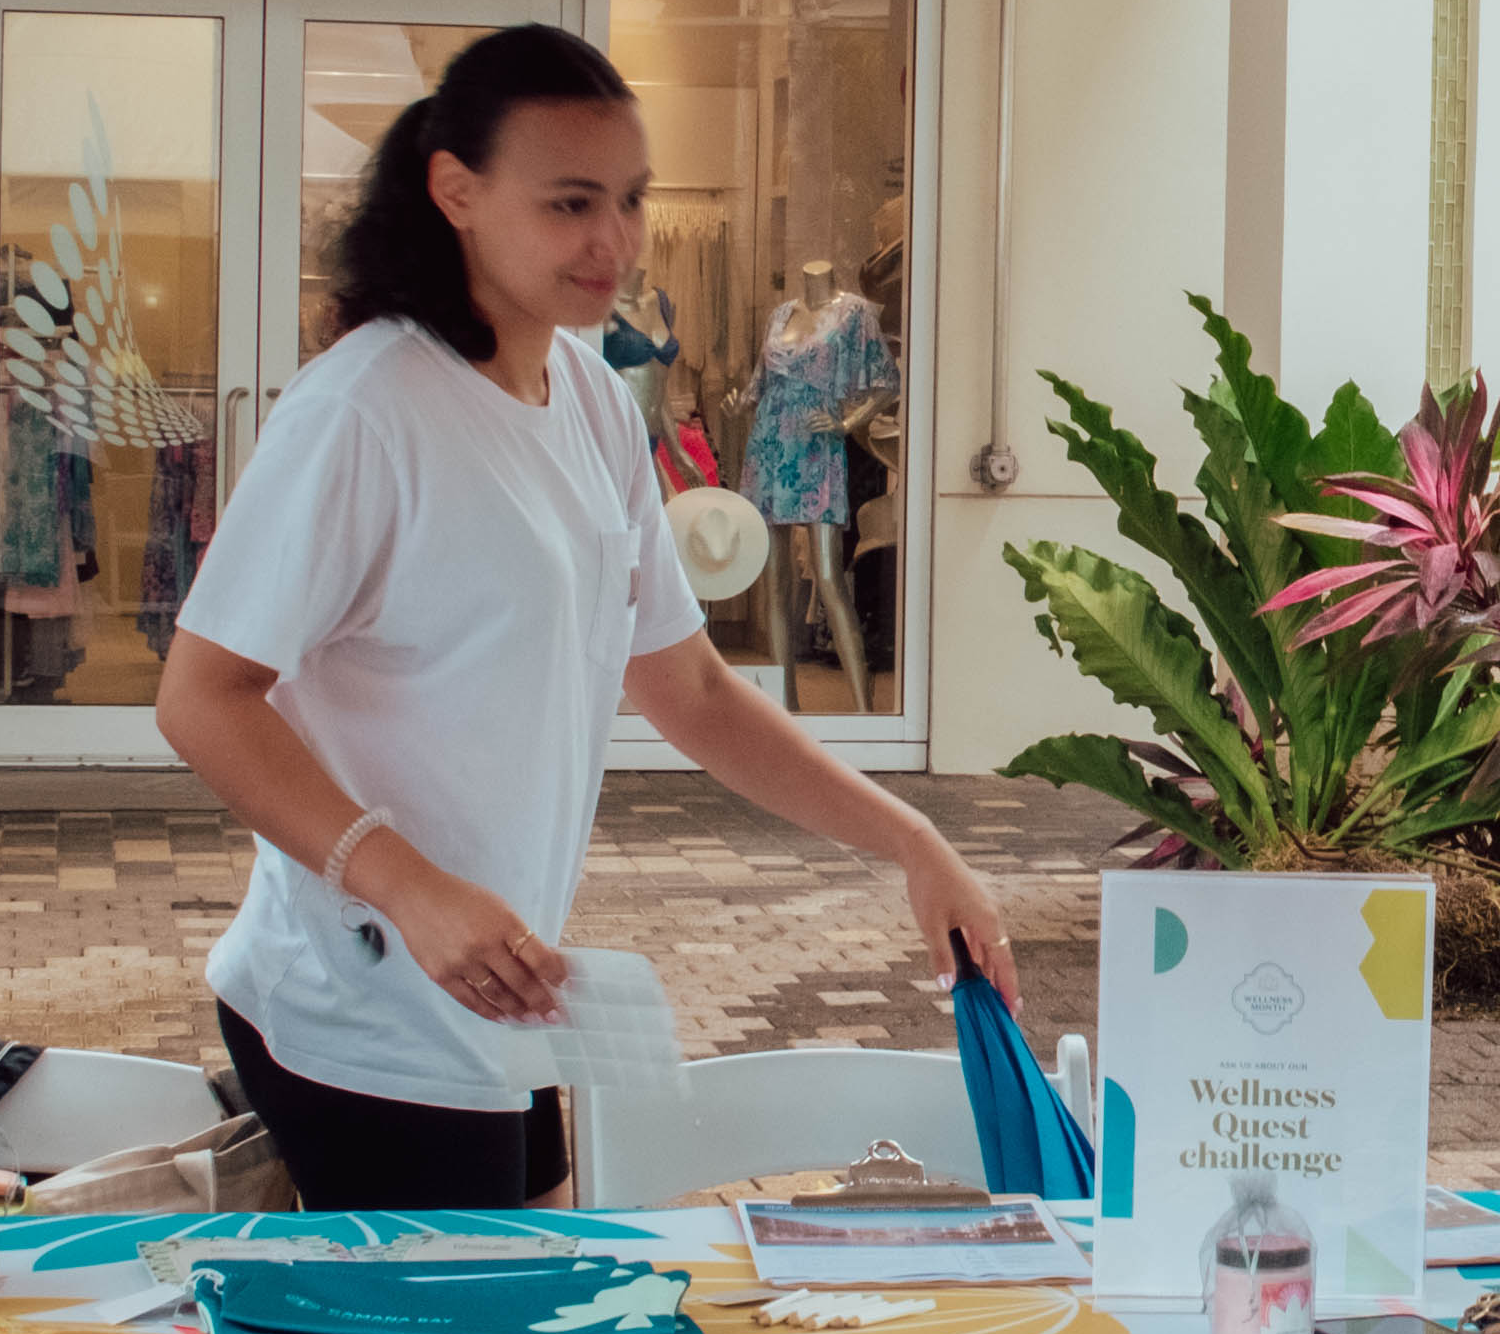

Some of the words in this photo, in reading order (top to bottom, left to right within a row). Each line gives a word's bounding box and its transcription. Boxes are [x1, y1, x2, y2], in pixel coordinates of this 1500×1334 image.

[1243, 994, 1293, 1005] WELLNESS
[1250, 1003, 1287, 1012] MONTH
[1254, 1061, 1286, 1071] ABOUT
[1188, 1078, 1337, 1109] Wellness
[1212, 1111, 1310, 1142] Quest
[1178, 1142, 1344, 1178] challenge
